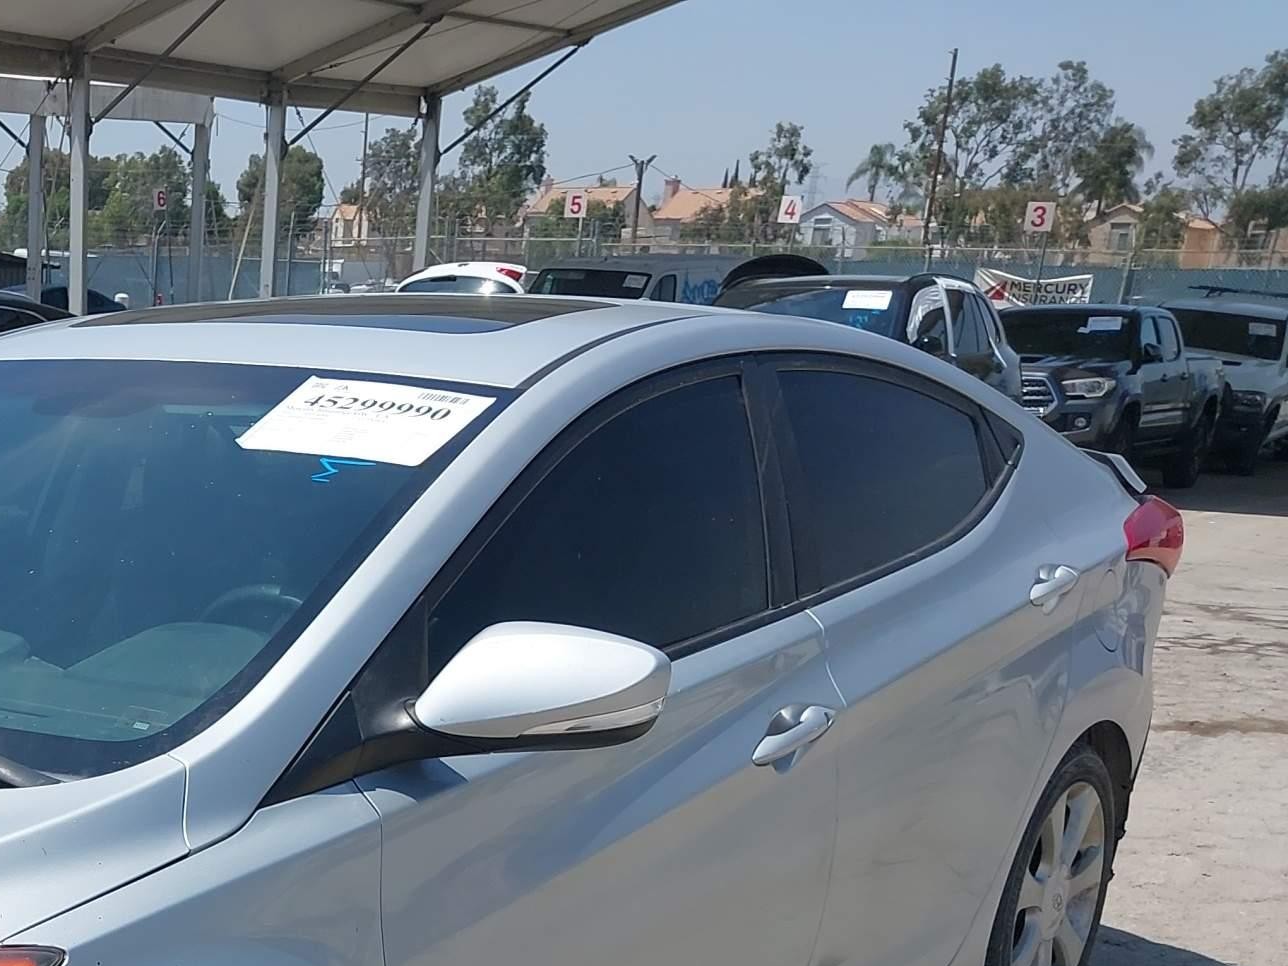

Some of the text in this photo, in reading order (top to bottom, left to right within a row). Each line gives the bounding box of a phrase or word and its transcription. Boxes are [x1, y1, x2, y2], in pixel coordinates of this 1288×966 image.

[157, 190, 166, 207] 6
[570, 195, 582, 215] 5
[784, 199, 796, 220] 4
[1030, 206, 1047, 227] 3
[1009, 281, 1088, 295] MERCURY
[304, 394, 452, 421] 45299990
